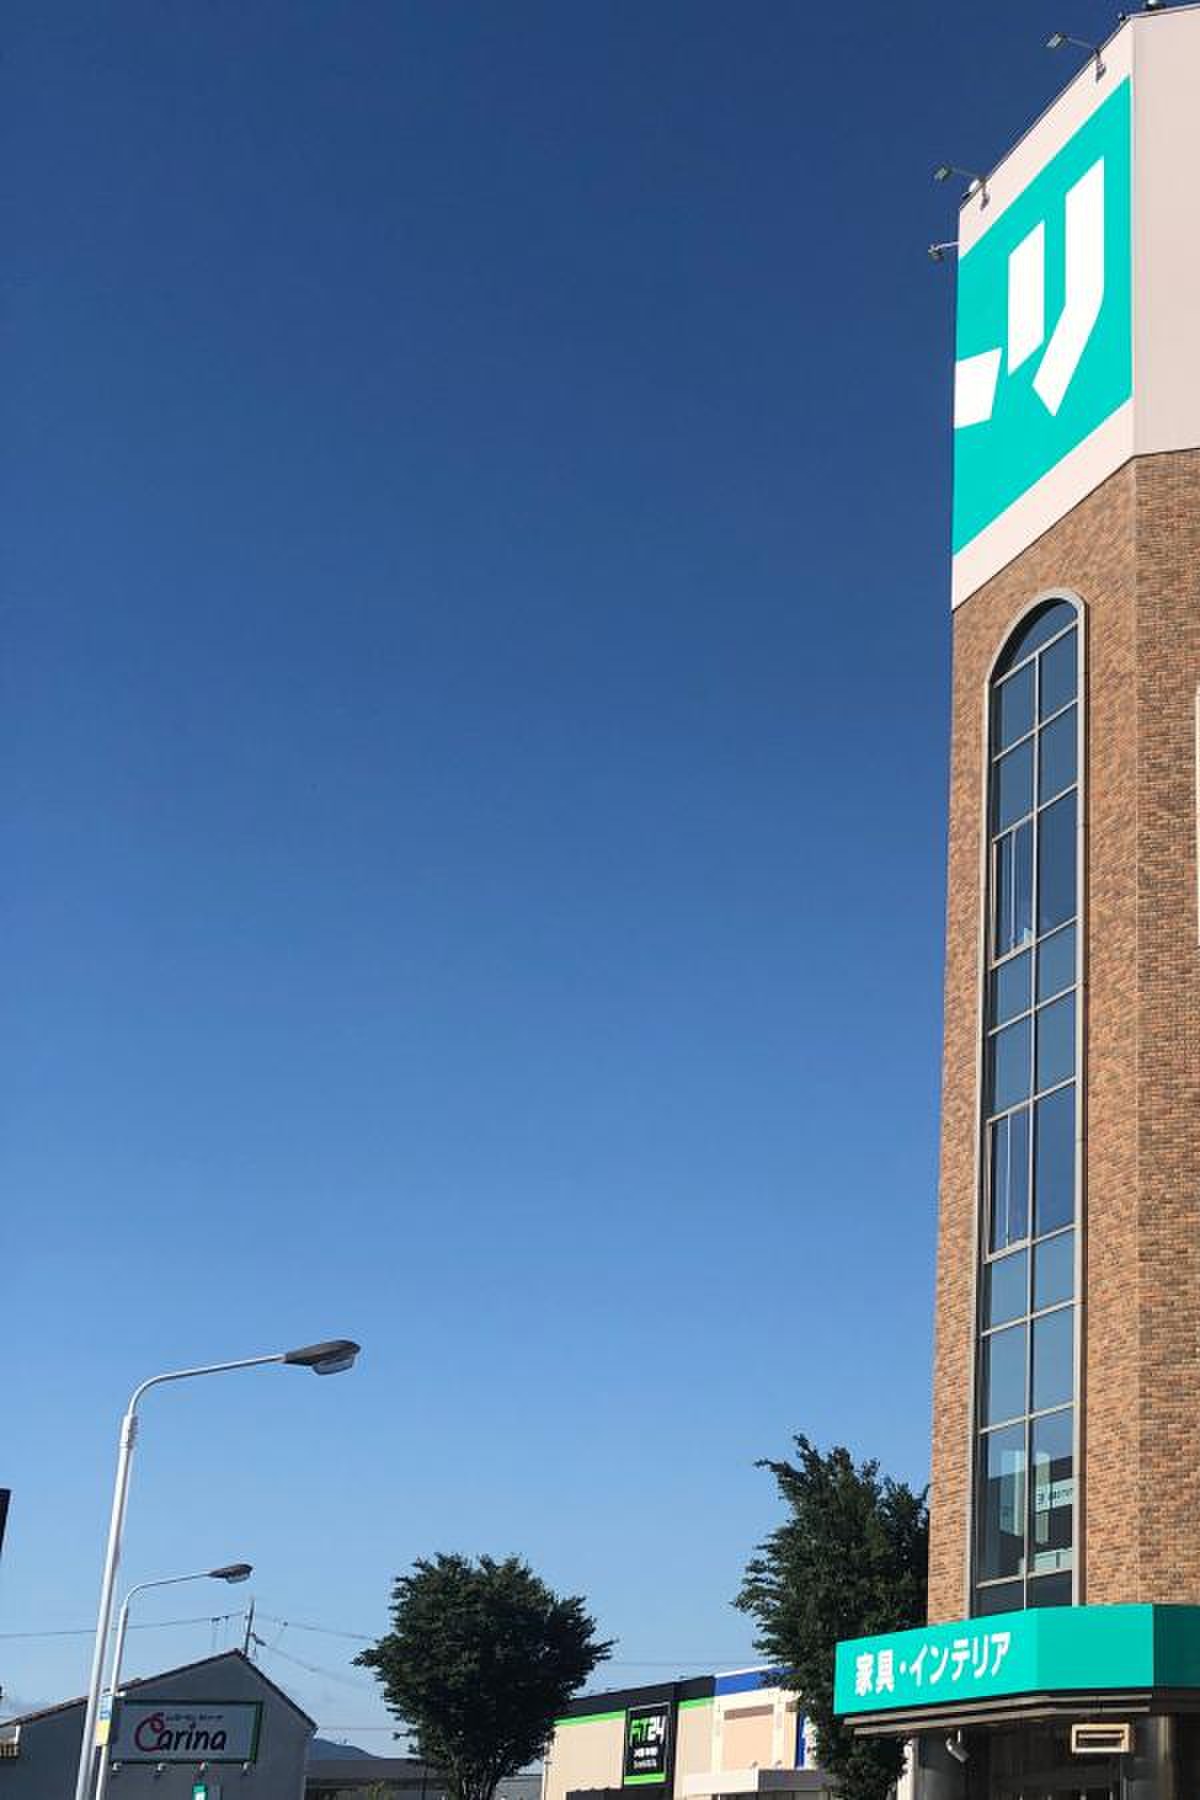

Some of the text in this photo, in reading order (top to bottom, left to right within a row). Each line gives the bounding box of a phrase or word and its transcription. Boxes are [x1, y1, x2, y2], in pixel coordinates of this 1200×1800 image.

[854, 1631, 1012, 1698] 家具・インテリア
[134, 1711, 227, 1752] Carina
